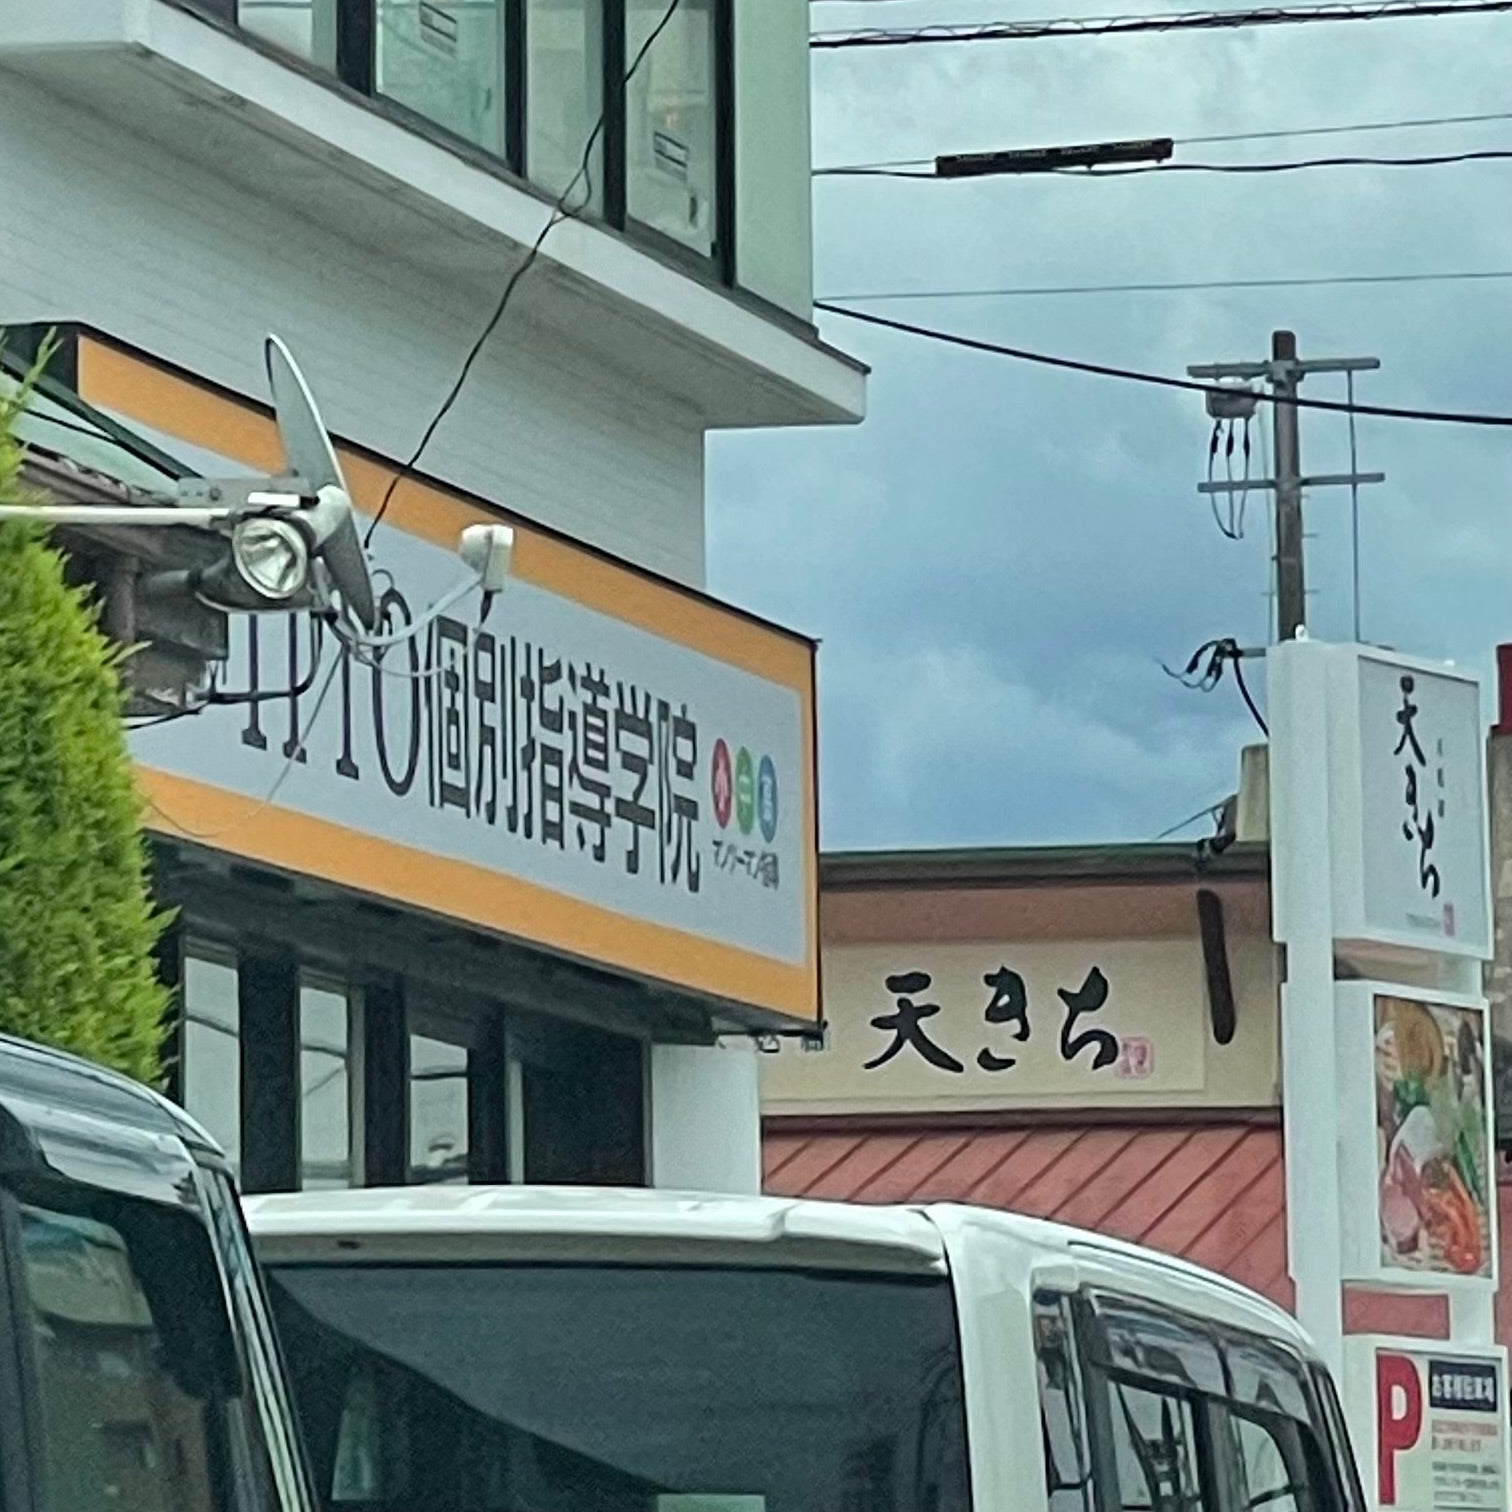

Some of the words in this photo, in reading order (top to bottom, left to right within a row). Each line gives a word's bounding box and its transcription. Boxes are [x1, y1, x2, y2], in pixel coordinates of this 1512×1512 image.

[863, 965, 1119, 1073] 天きち
[1376, 1355, 1423, 1506] P
